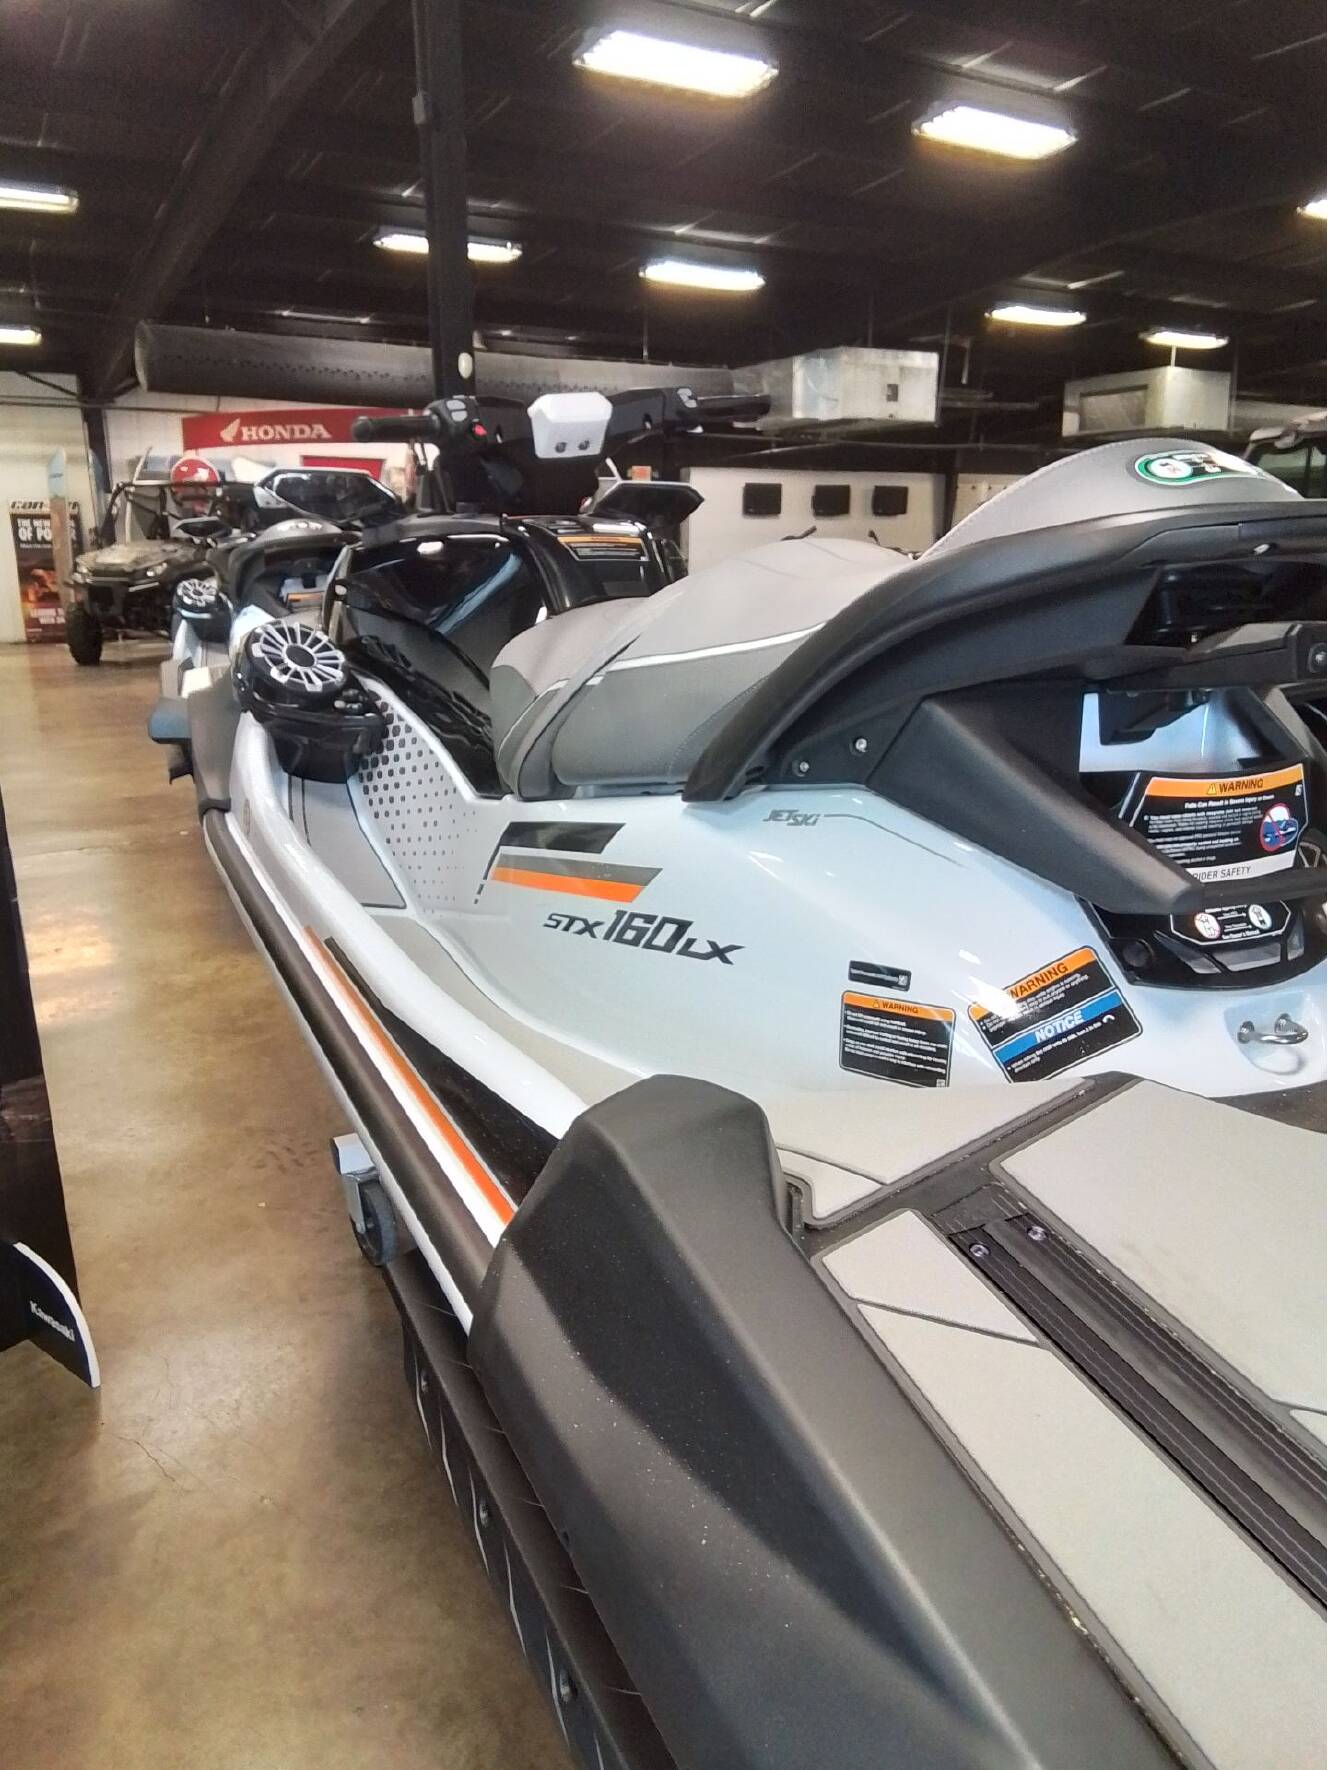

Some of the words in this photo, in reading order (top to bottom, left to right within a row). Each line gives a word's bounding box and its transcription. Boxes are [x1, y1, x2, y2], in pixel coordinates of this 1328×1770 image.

[241, 424, 332, 441] HONDA
[18, 527, 33, 542] OF
[1218, 778, 1264, 794] WARNING
[1220, 866, 1251, 879] SAFETY
[881, 1001, 920, 1014] WARNING
[1034, 1009, 1086, 1042] NOTICE
